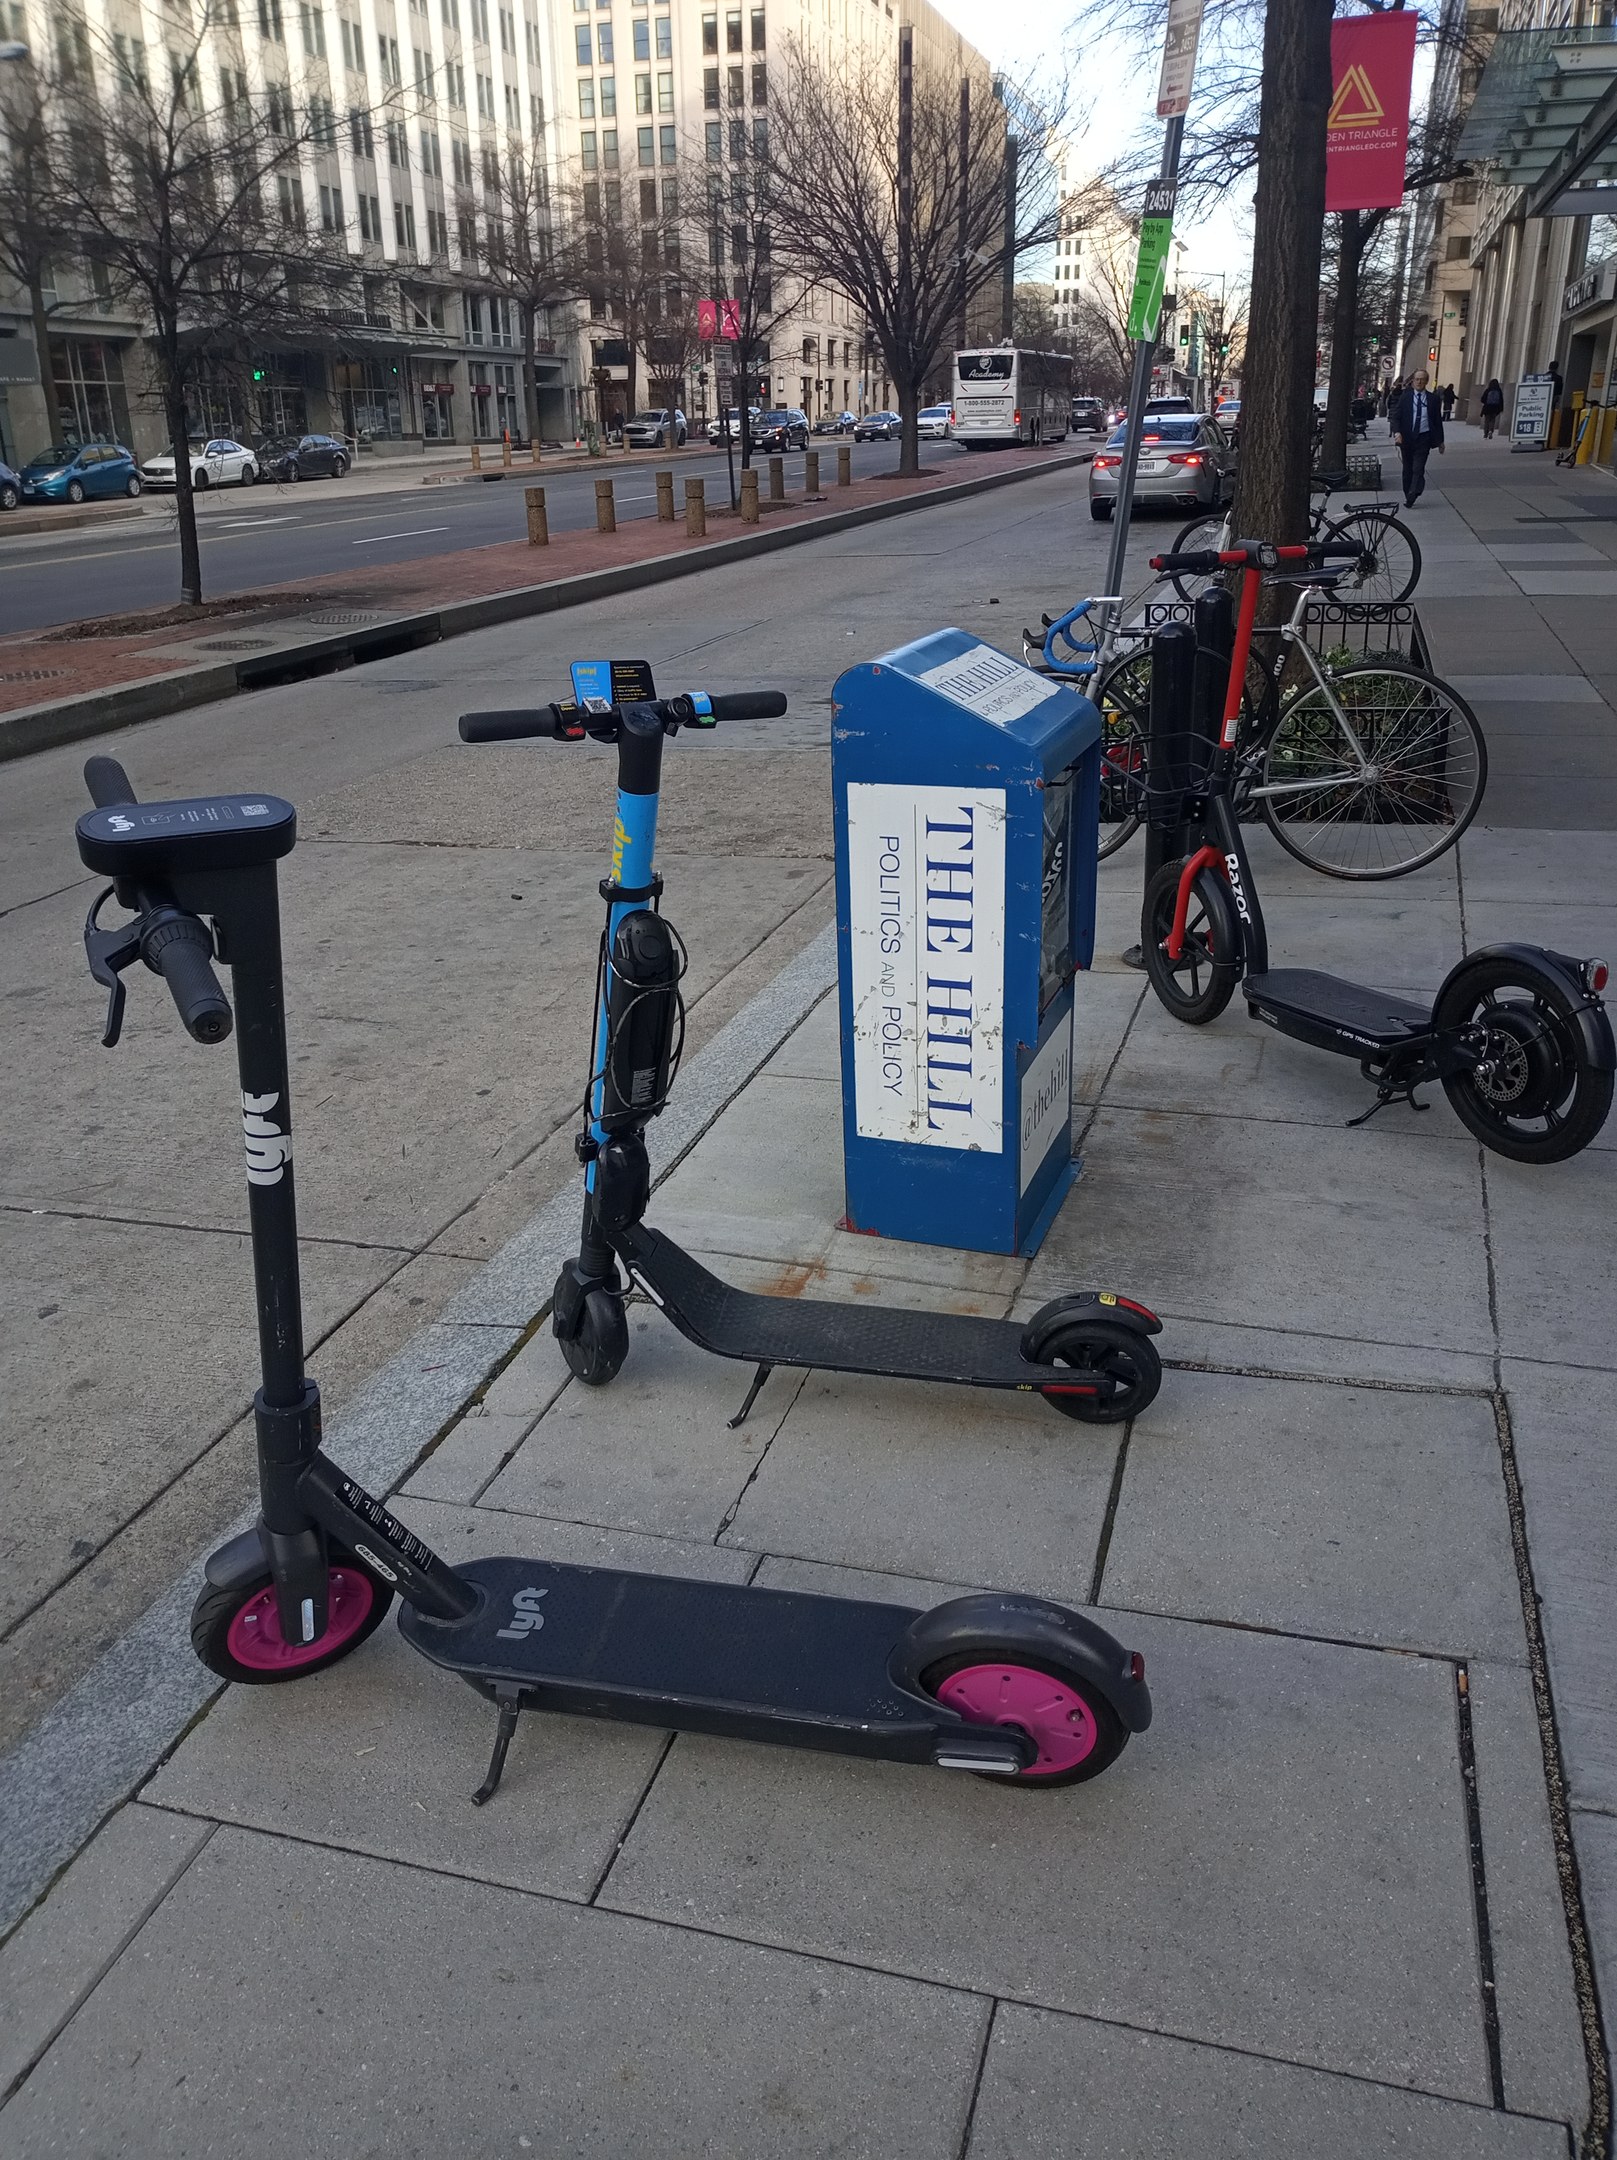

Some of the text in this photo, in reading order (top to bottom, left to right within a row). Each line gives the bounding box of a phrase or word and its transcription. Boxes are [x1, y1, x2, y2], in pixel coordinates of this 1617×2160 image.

[1349, 128, 1398, 140] TRIANGLE
[1148, 190, 1174, 211] 24531
[968, 369, 1004, 379] Academy
[1519, 423, 1531, 432] $18
[935, 656, 1019, 701] THE HILL
[107, 814, 136, 833] lyft
[1225, 853, 1251, 925] Razor
[879, 836, 903, 1097] POLITICS AND POLICY
[926, 806, 974, 1131] THE HILL
[1022, 1048, 1068, 1151] @thehill
[242, 1088, 294, 1186] lyft
[357, 1545, 395, 1579] 685-465
[496, 1587, 549, 1640] lyft
